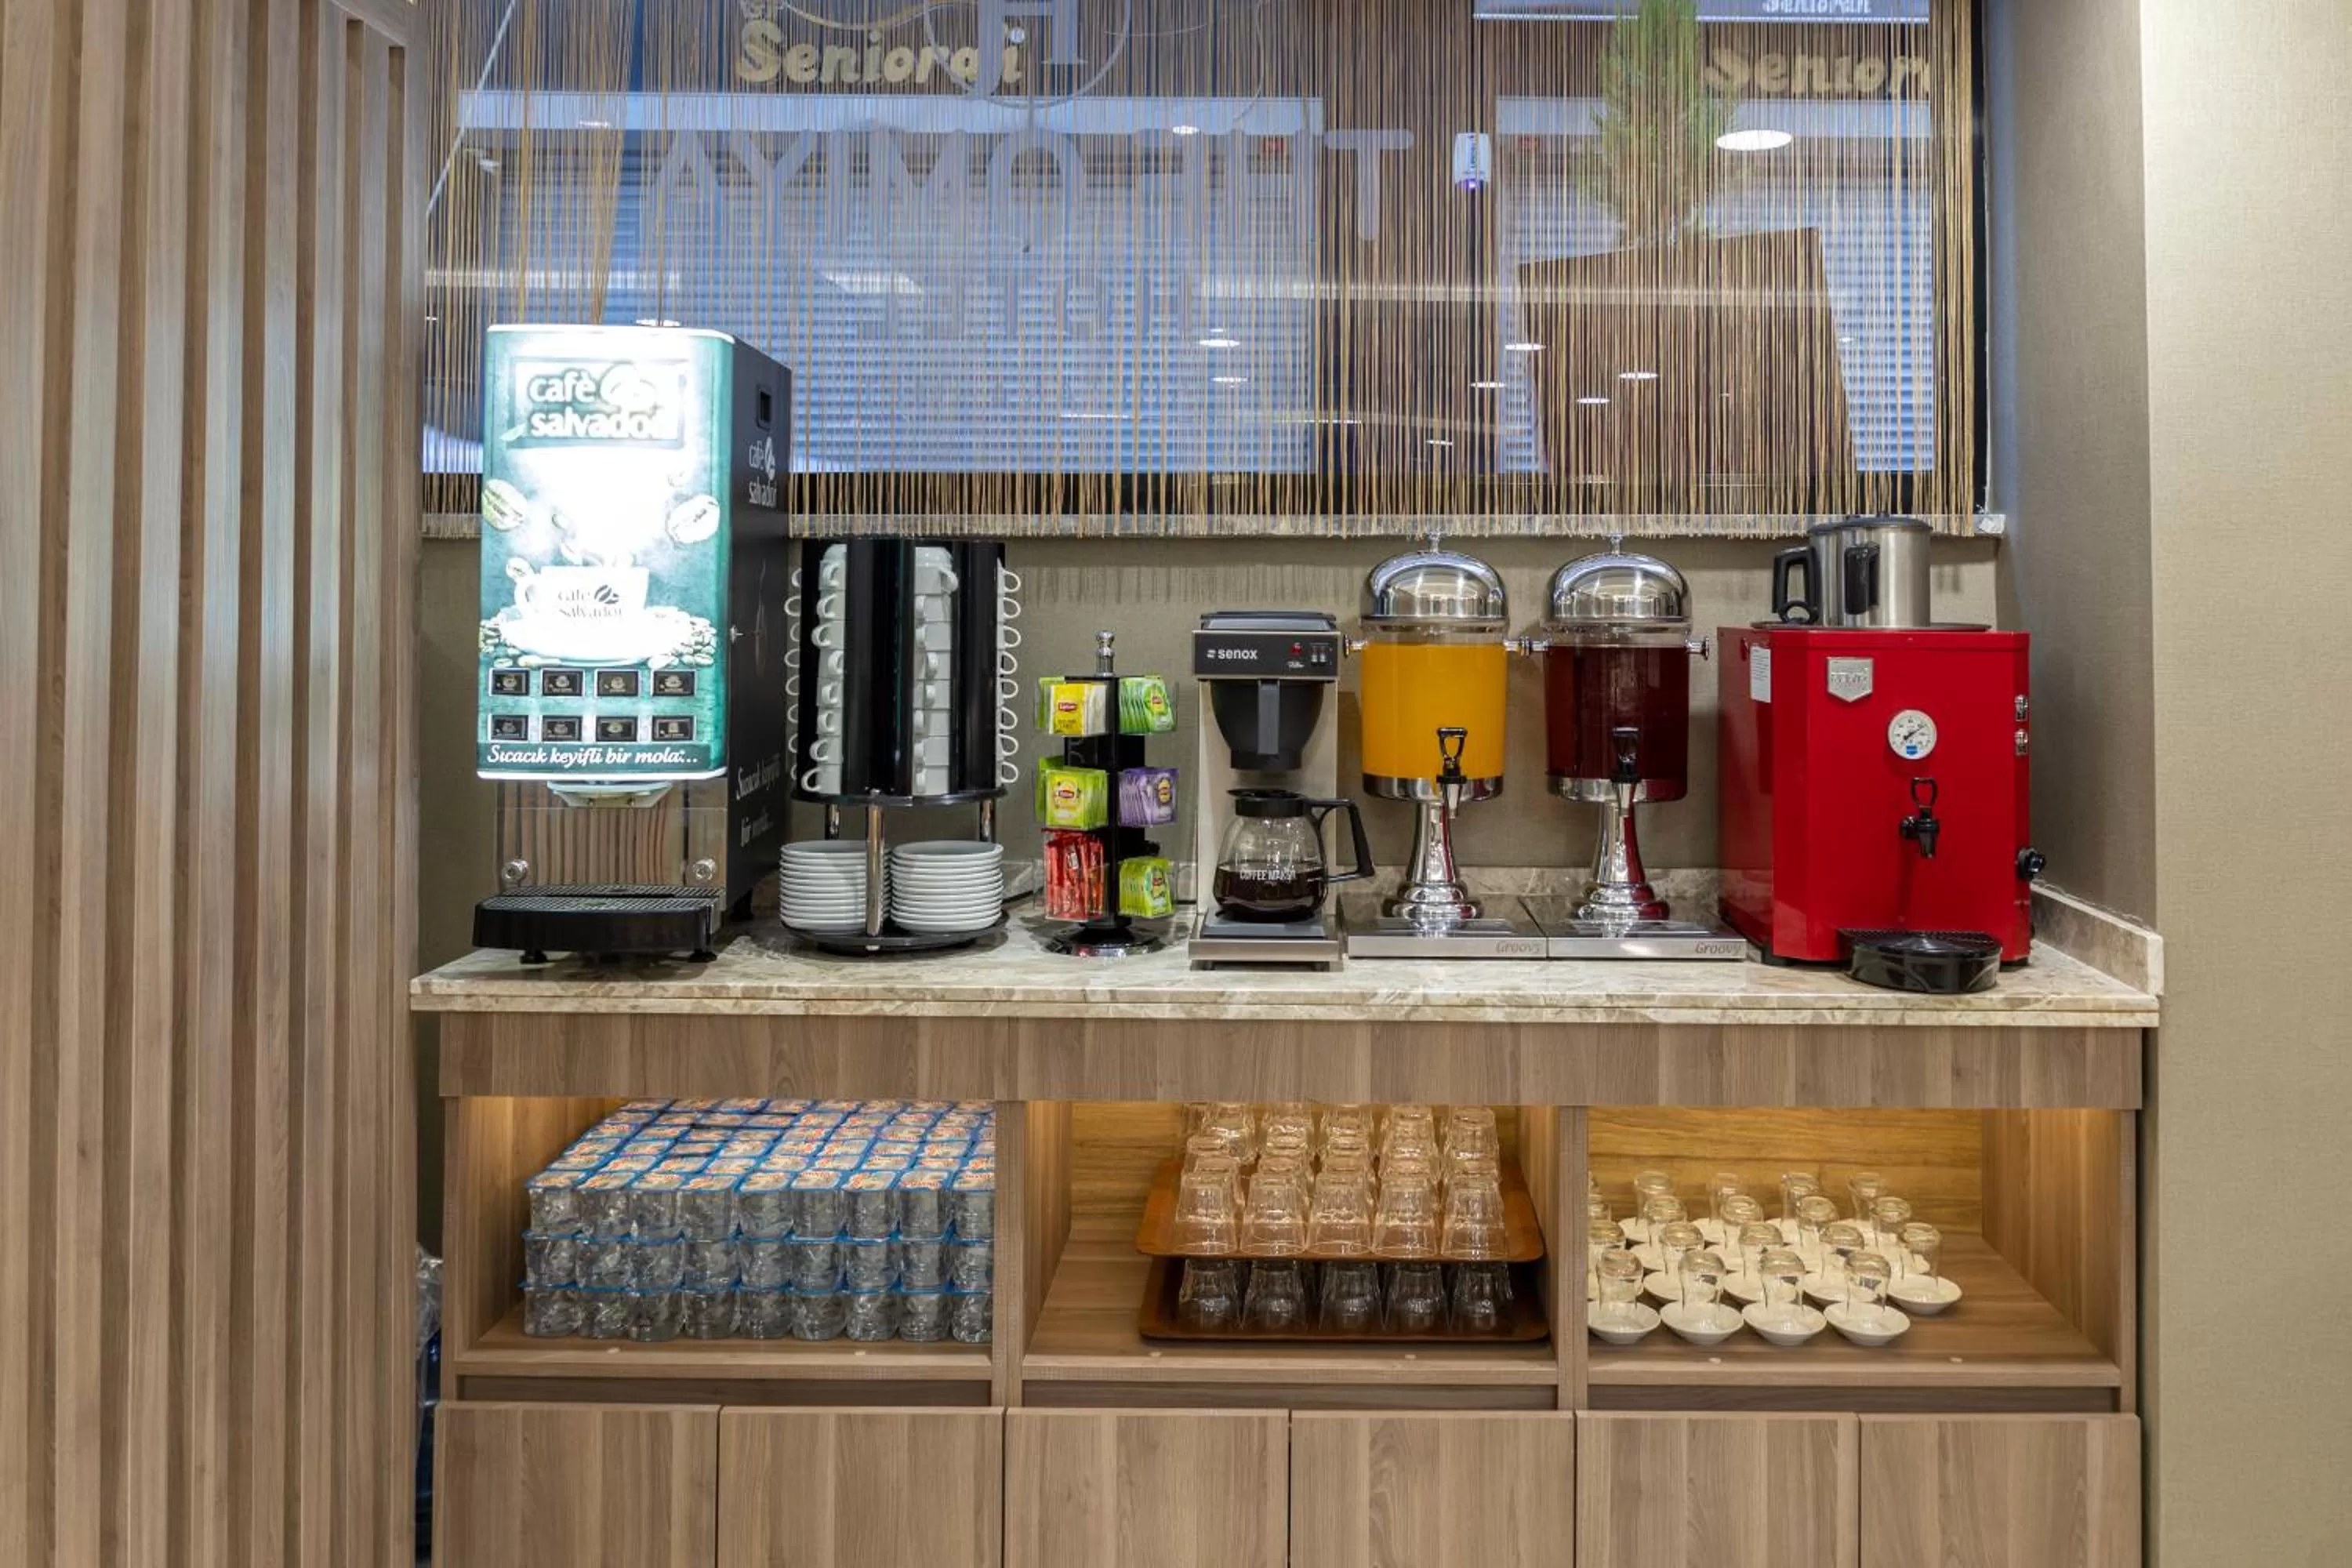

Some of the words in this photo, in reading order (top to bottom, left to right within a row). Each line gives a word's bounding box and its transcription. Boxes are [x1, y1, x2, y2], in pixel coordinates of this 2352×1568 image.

[1218, 649, 1258, 659] senox
[606, 747, 632, 763] bir
[1695, 941, 1742, 955] Groovy
